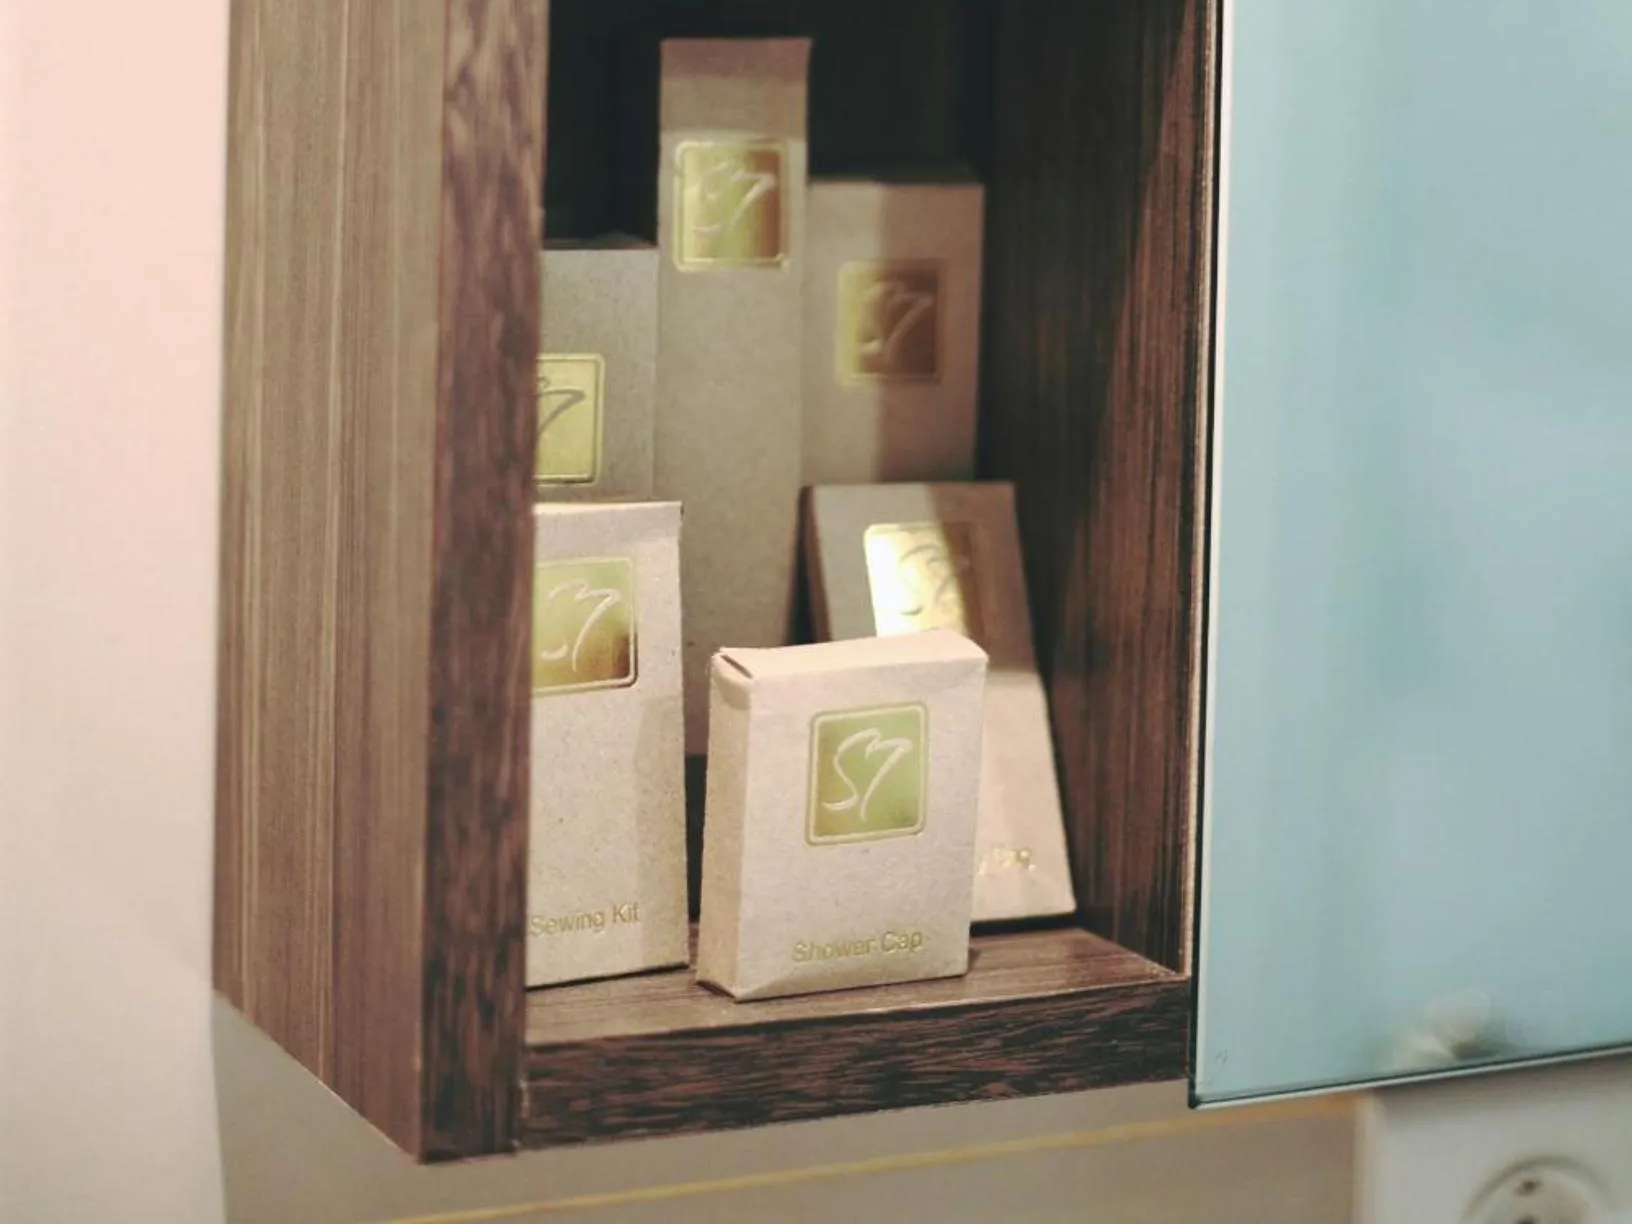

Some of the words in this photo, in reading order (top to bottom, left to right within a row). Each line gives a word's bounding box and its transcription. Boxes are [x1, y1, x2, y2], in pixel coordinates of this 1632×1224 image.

[529, 912, 606, 938] Sewing
[611, 901, 641, 925] Kit
[791, 938, 875, 964] Shower
[880, 930, 923, 955] Cap
